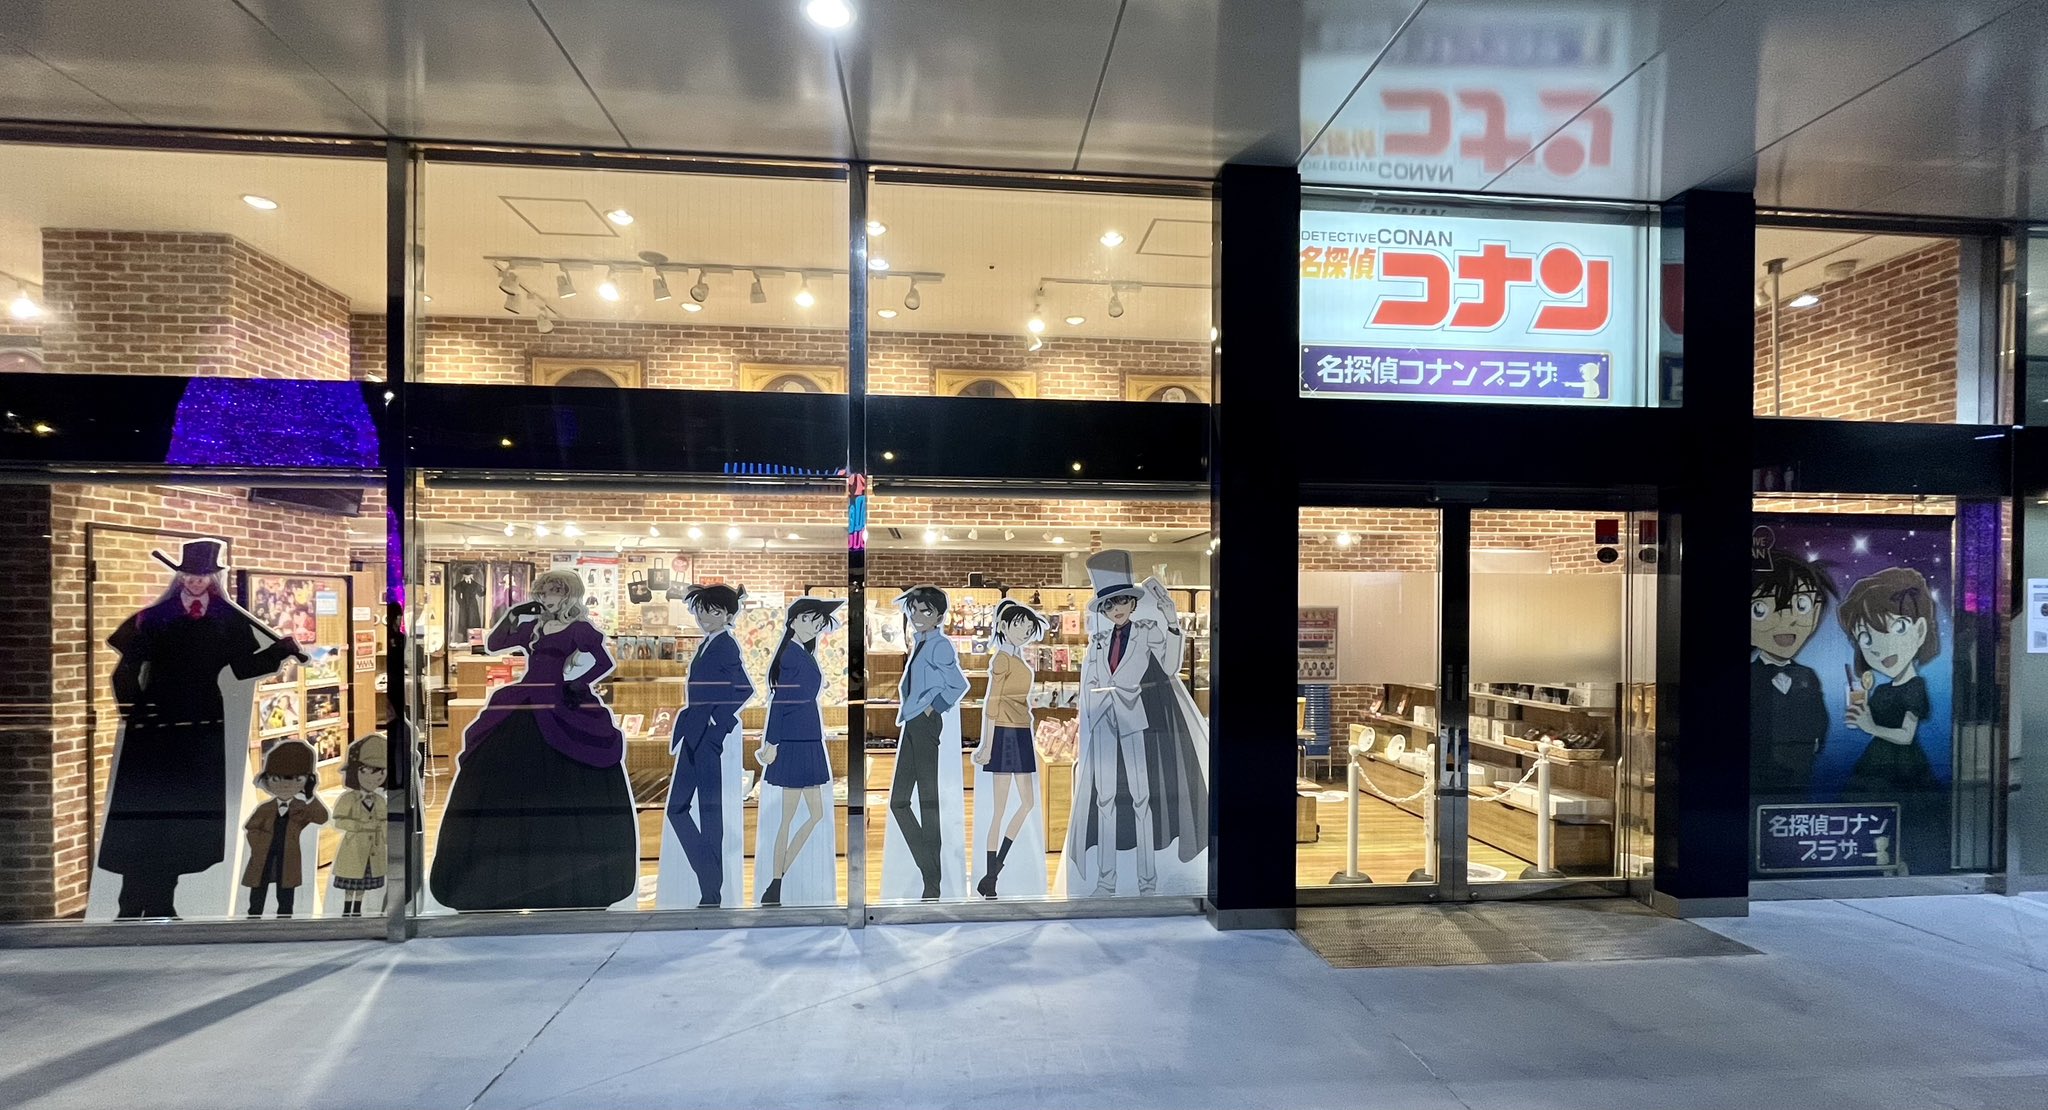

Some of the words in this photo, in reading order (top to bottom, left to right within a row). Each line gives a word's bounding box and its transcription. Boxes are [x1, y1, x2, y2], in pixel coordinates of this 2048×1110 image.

[1301, 230, 1377, 244] DETECTIVE
[1377, 228, 1453, 247] CONAN
[1300, 245, 1377, 281] 名探偵
[1370, 242, 1611, 333] コナン
[1316, 353, 1559, 388] 名探偵コナンプラザ
[1768, 813, 1889, 838] 名探偵コナン
[1798, 839, 1858, 862] プラザ
